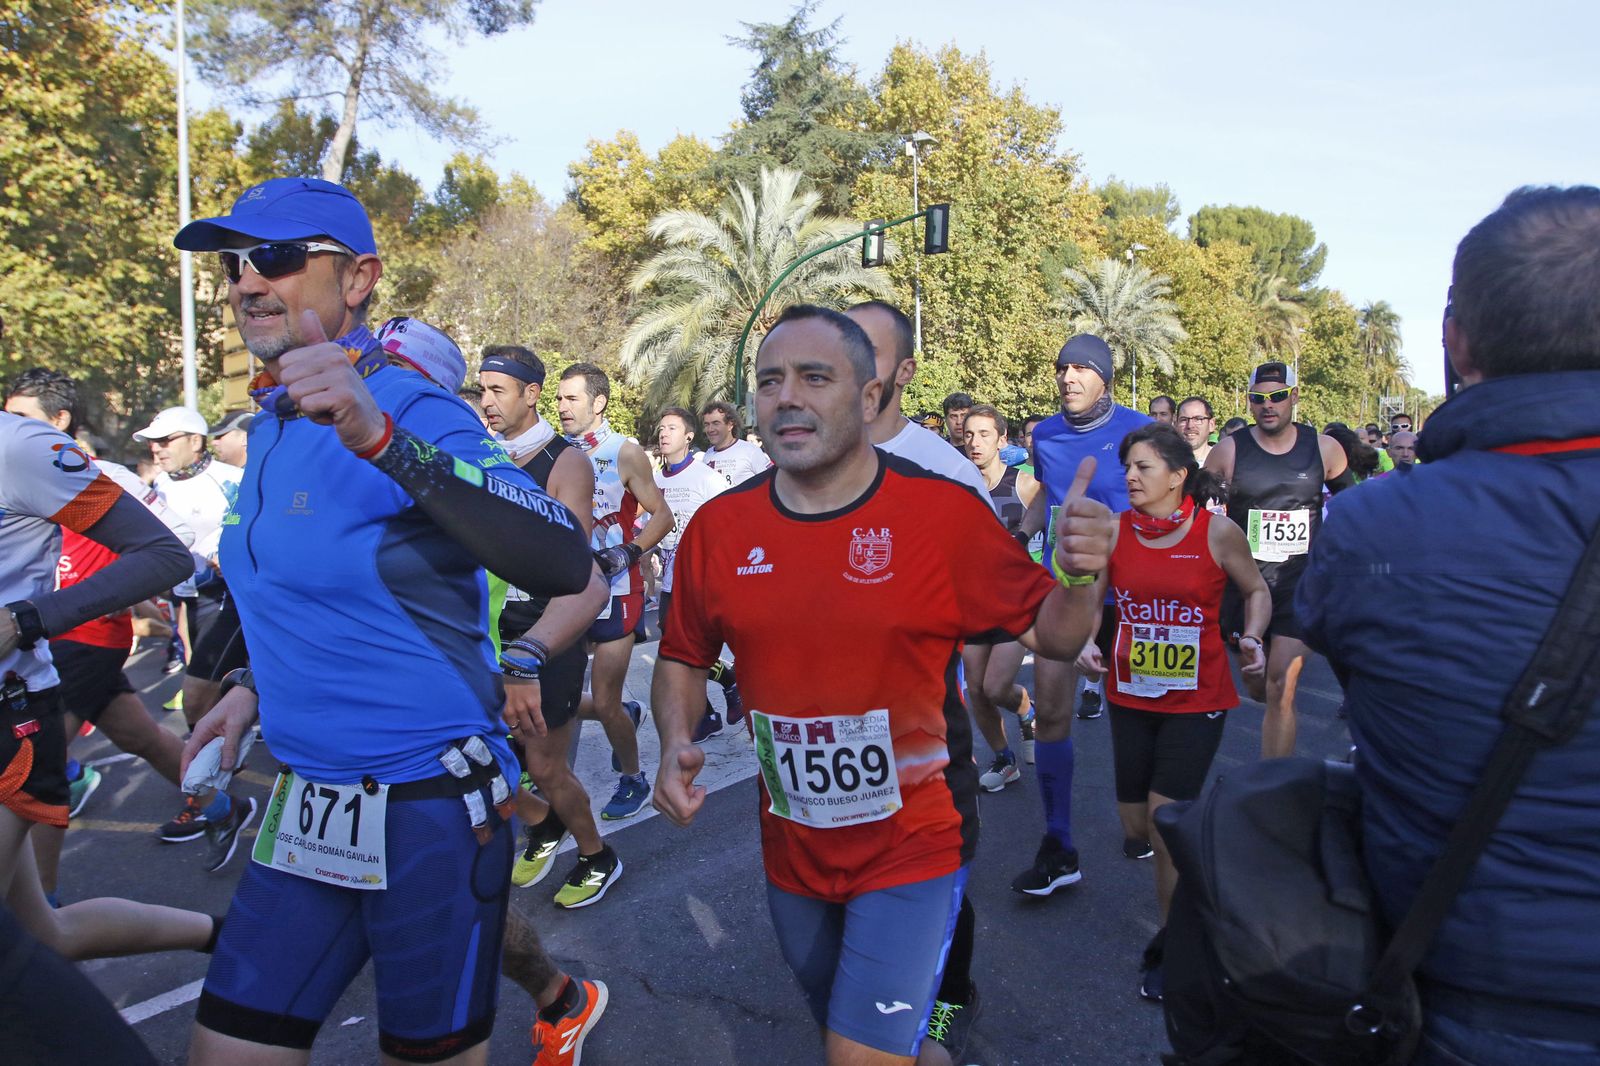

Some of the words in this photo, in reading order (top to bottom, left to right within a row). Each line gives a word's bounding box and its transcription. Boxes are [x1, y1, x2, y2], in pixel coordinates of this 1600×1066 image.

[487, 477, 553, 522] URBANO,
[852, 527, 893, 538] C.A.B.
[1263, 522, 1307, 542] 1532
[737, 563, 773, 576] VIATOR
[1127, 599, 1204, 624] califas
[1132, 641, 1196, 671] 3102
[1151, 670, 1178, 678] COBACHO
[853, 715, 887, 726] MEDIA
[839, 725, 888, 737] MARATÓN
[780, 744, 890, 795] 1569
[827, 796, 858, 806] BUESO
[859, 787, 896, 801] JUAREZ
[299, 782, 362, 848] 671
[276, 832, 292, 844] JOSE
[293, 837, 317, 852] CARLOS
[317, 844, 345, 858] ROMÁN
[346, 850, 380, 864] GAVILÁN
[315, 868, 350, 881] Cruzcampo
